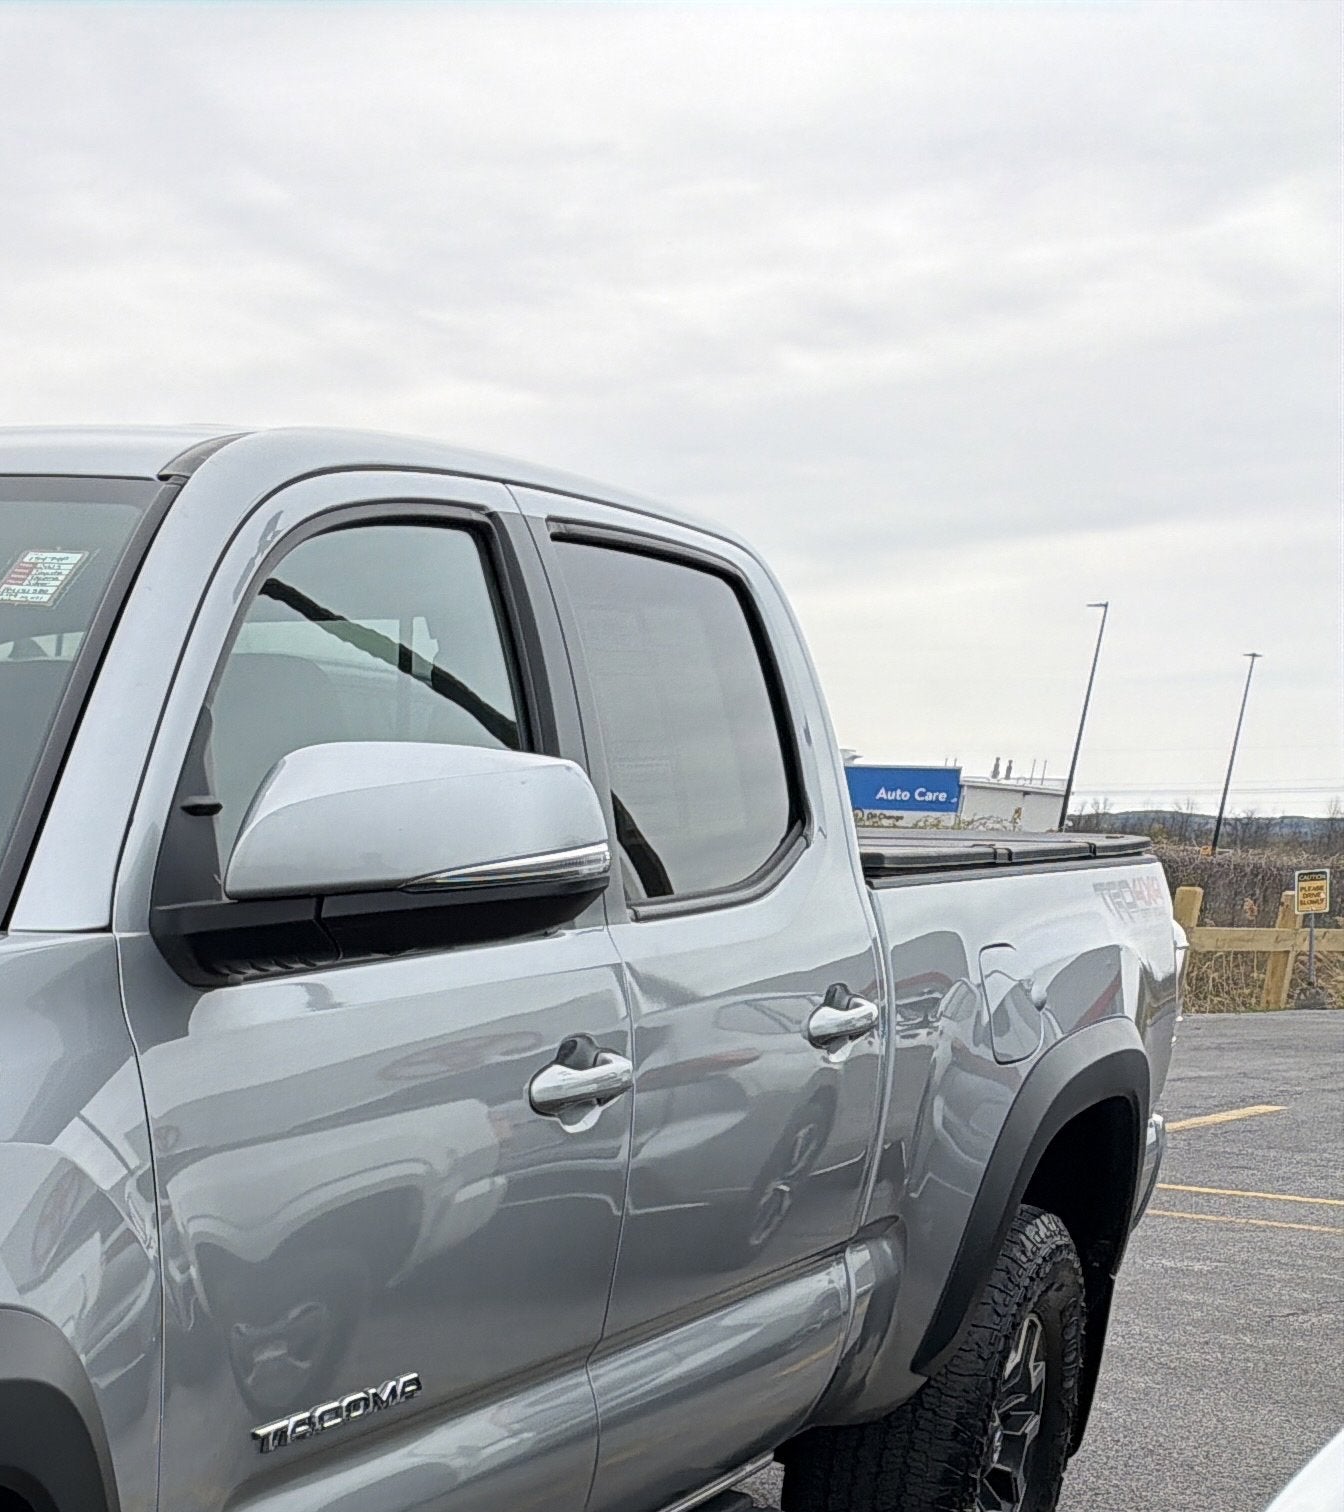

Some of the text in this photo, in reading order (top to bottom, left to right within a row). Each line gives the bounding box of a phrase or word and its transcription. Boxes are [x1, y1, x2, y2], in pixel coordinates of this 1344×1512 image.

[875, 786, 948, 802] Auto Care
[1298, 873, 1327, 881] CAUTION
[250, 1372, 422, 1453] TACOMA
